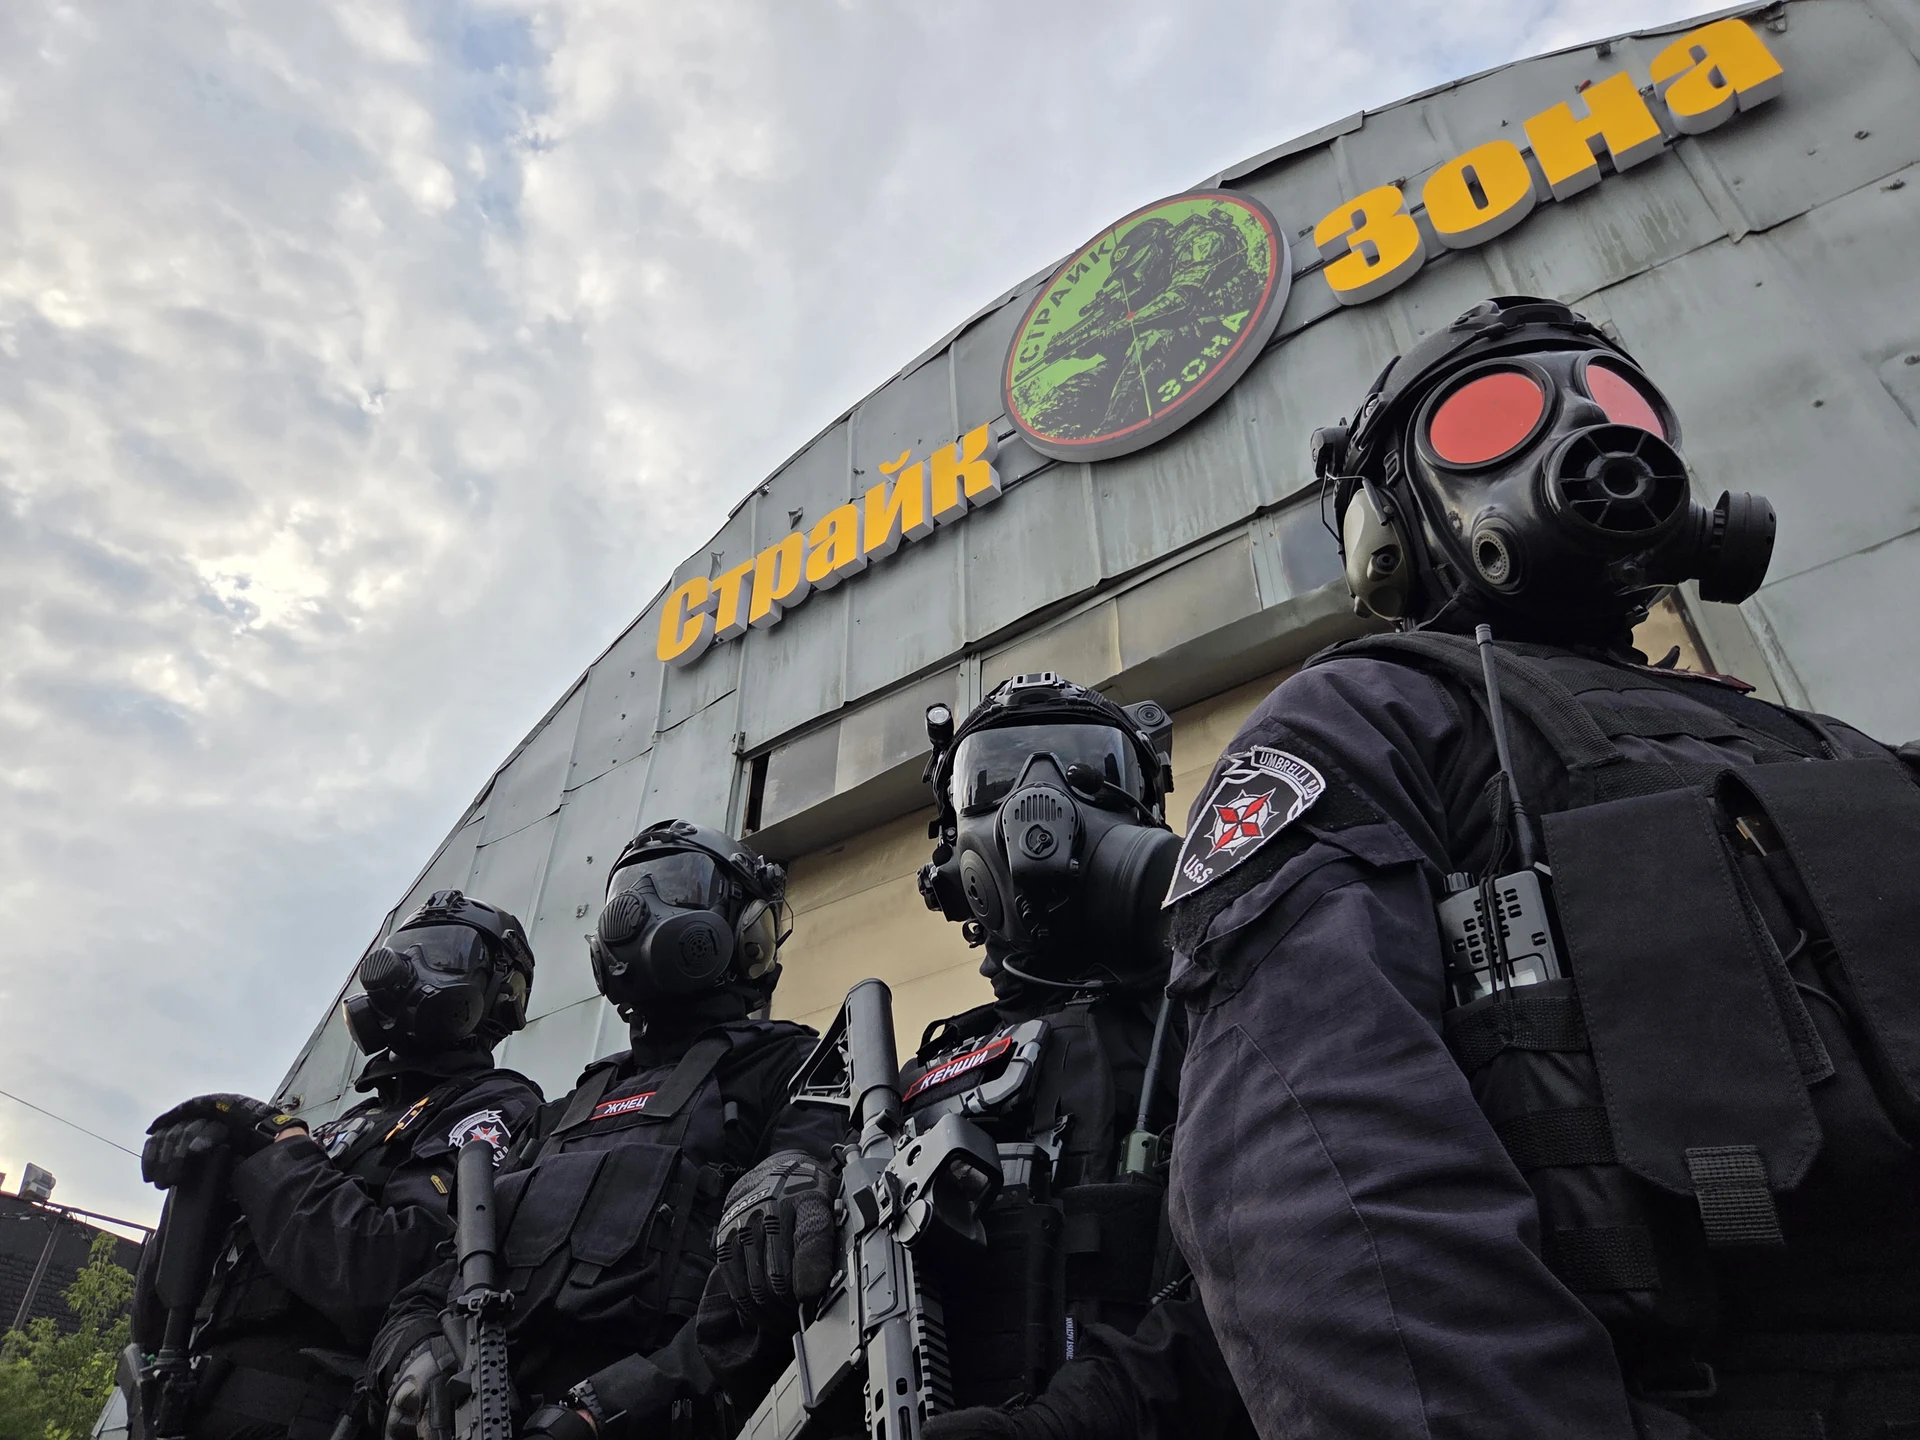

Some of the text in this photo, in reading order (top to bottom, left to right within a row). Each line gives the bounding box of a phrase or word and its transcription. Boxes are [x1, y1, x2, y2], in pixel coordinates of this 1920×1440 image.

[1018, 238, 1114, 364] СТРАЙК
[1157, 309, 1250, 402] ЗОНА
[1259, 751, 1310, 784] UMBRELLA
[919, 1049, 989, 1091] КЕНШИ
[604, 1095, 649, 1115] ЖНЕЦ
